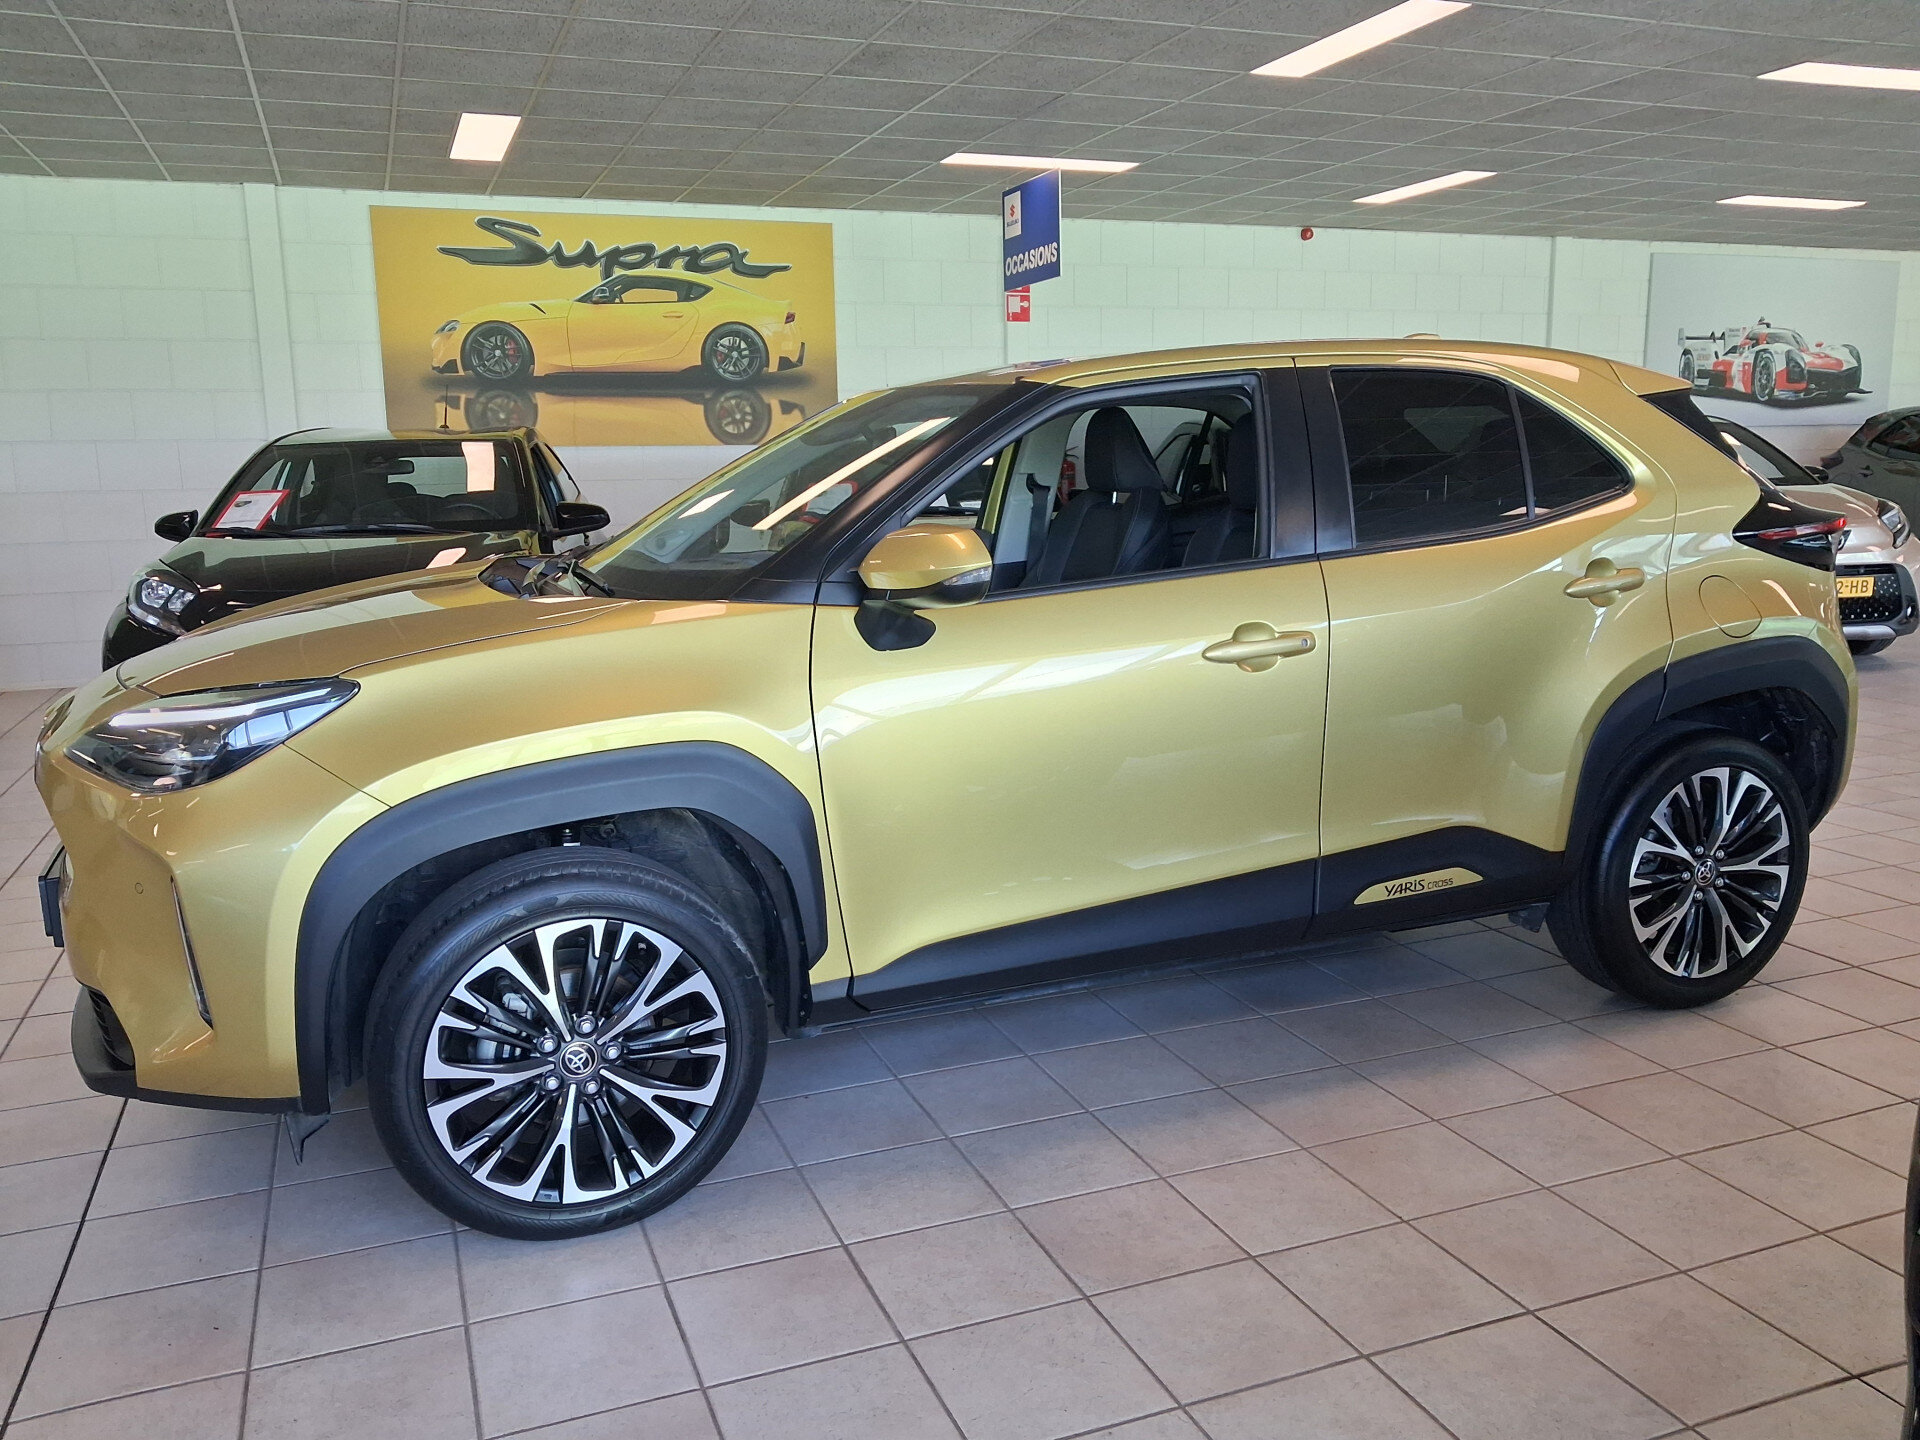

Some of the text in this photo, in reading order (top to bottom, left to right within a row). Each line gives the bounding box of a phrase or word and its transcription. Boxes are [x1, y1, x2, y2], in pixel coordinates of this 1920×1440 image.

[436, 216, 792, 281] Supra
[1005, 241, 1058, 276] OCCASIONS
[1427, 878, 1454, 890] CROSS
